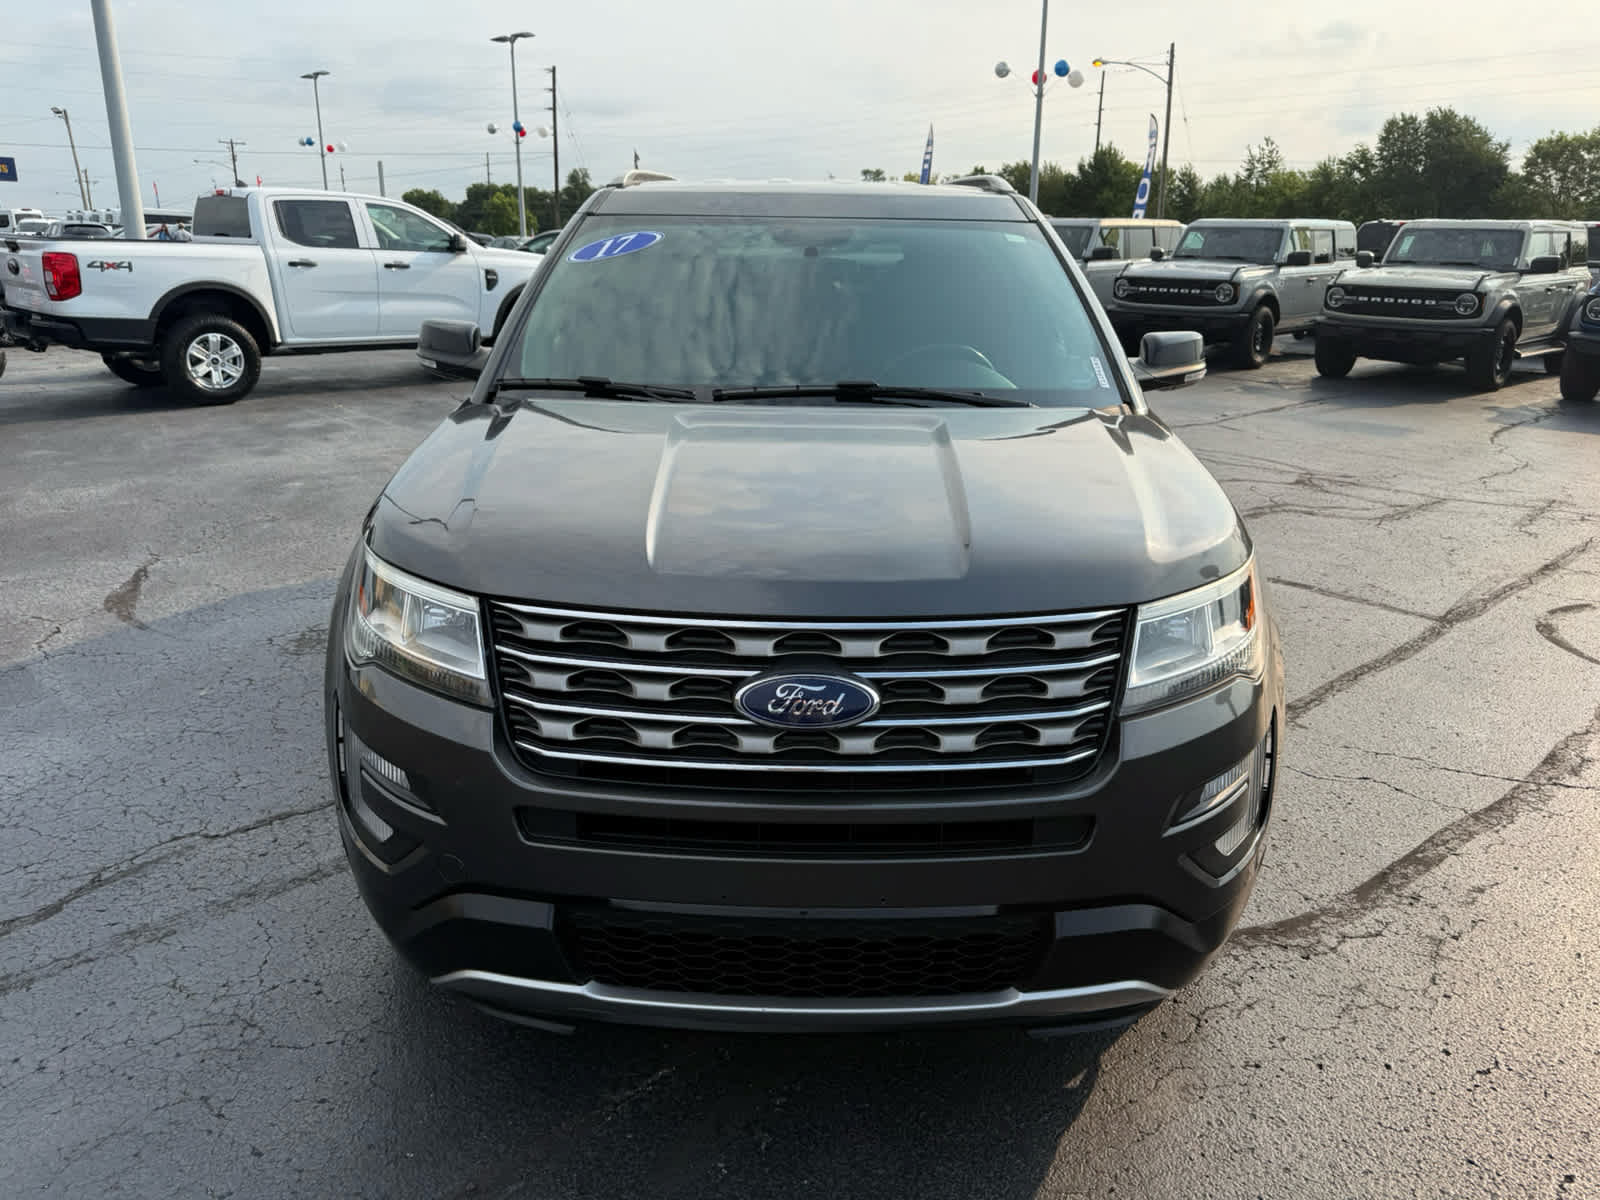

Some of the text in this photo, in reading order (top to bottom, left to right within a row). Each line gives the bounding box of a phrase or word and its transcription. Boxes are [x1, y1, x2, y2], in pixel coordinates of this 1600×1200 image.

[595, 232, 639, 258] 17
[1138, 287, 1201, 295] BRONCO
[1358, 296, 1437, 305] BRONCO
[767, 683, 846, 716] Ford
